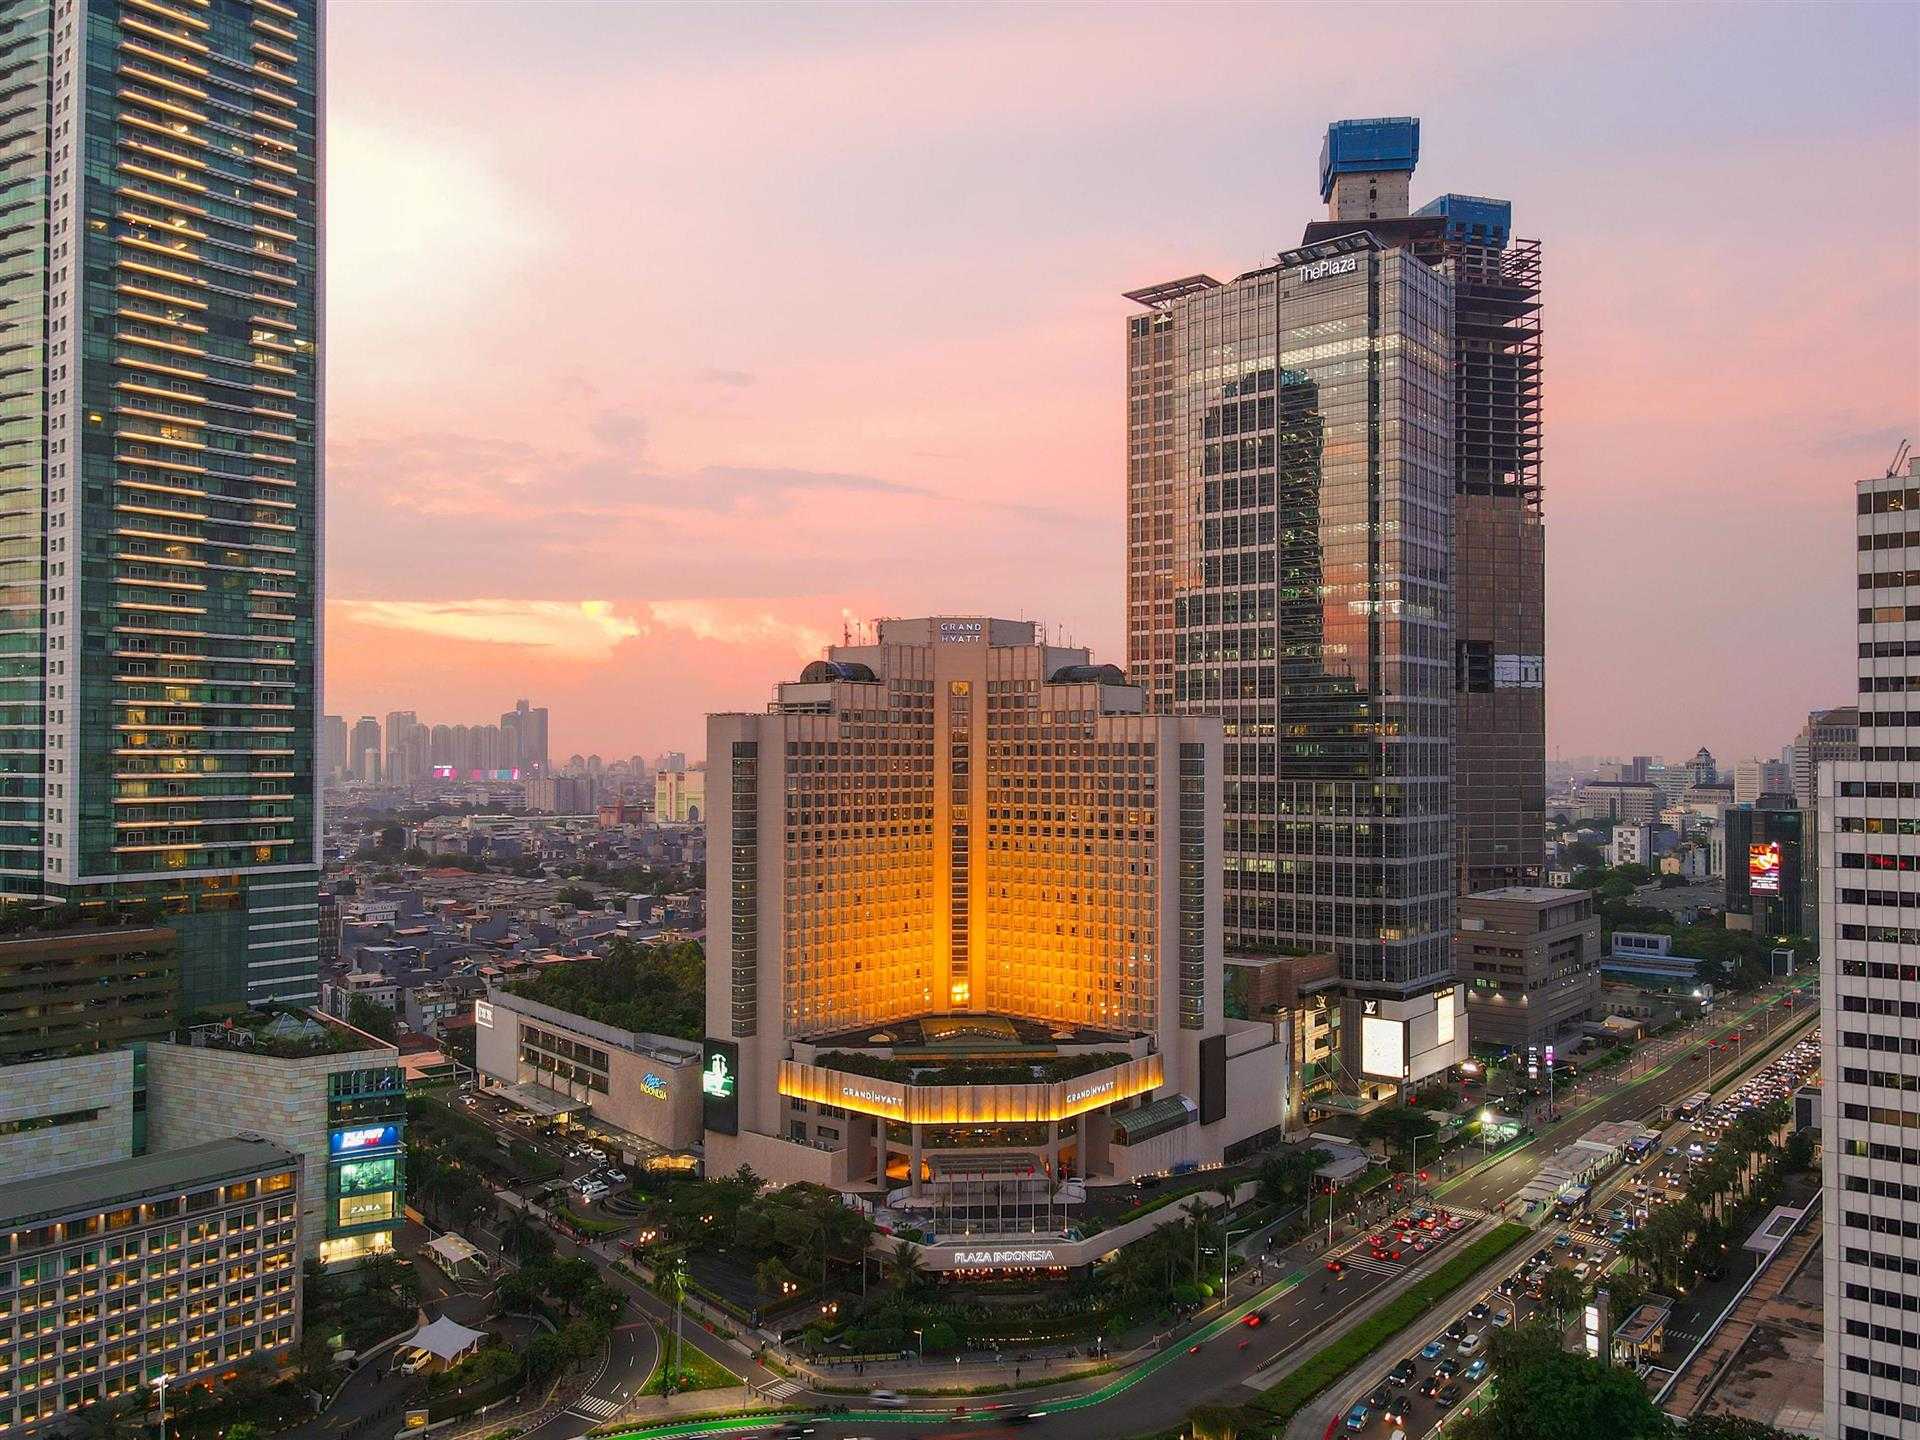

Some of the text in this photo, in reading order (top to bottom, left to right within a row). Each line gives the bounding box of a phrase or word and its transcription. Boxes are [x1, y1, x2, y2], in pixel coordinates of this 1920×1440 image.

[1298, 258, 1356, 281] ThePlaza
[940, 623, 982, 631] GRAND
[941, 635, 980, 643] HYATT
[350, 1204, 381, 1214] ZARA
[954, 1250, 1055, 1263] PLAZA INDONESIA
